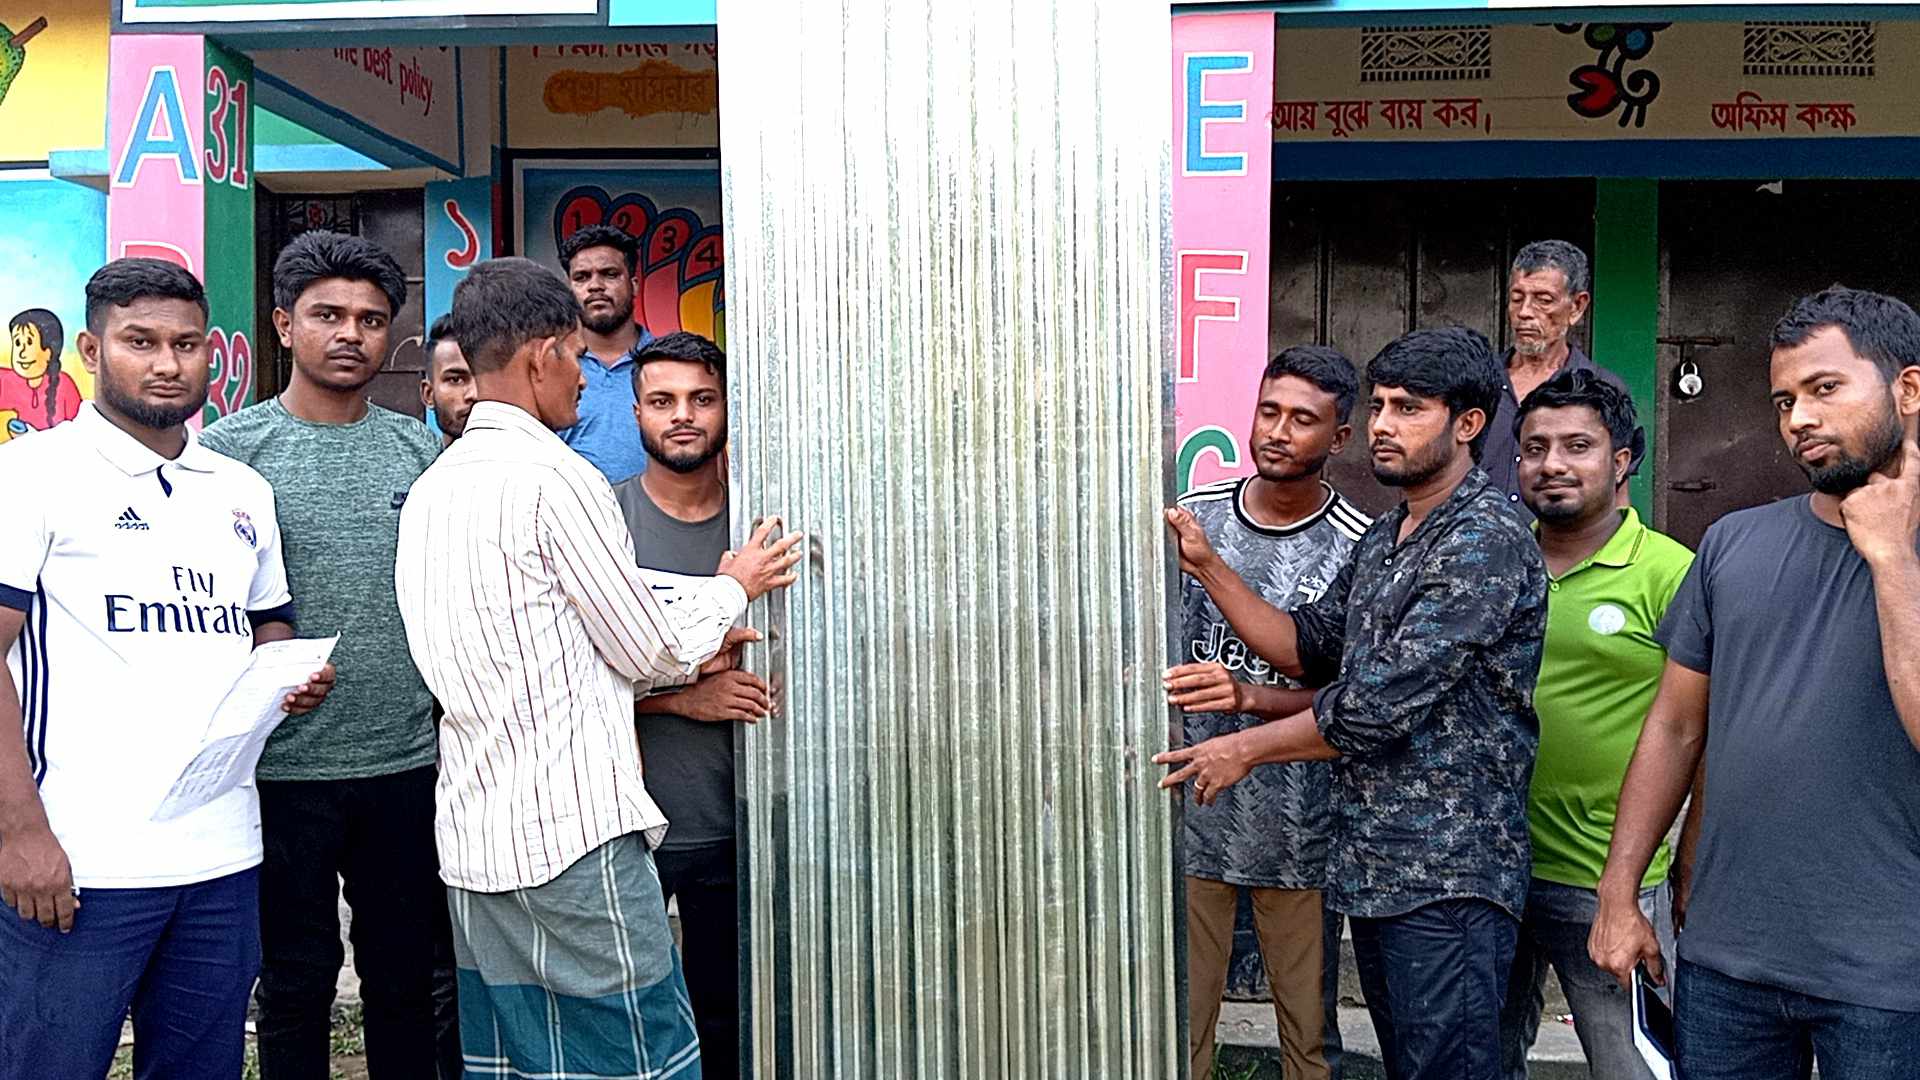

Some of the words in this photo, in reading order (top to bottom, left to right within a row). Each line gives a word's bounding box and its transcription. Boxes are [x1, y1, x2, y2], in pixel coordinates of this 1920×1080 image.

[399, 56, 436, 116] policy.
[1182, 51, 1254, 176] E
[112, 65, 200, 188] A
[206, 66, 249, 189] 31
[1324, 101, 1373, 138] বুঝে
[1380, 99, 1426, 131] ব্যয়
[1795, 103, 1857, 133] কক্ষ
[661, 225, 679, 254] 3
[695, 239, 719, 269] 4
[1175, 250, 1249, 383] F
[172, 566, 214, 598] Fly
[1192, 623, 1306, 689] Jee
